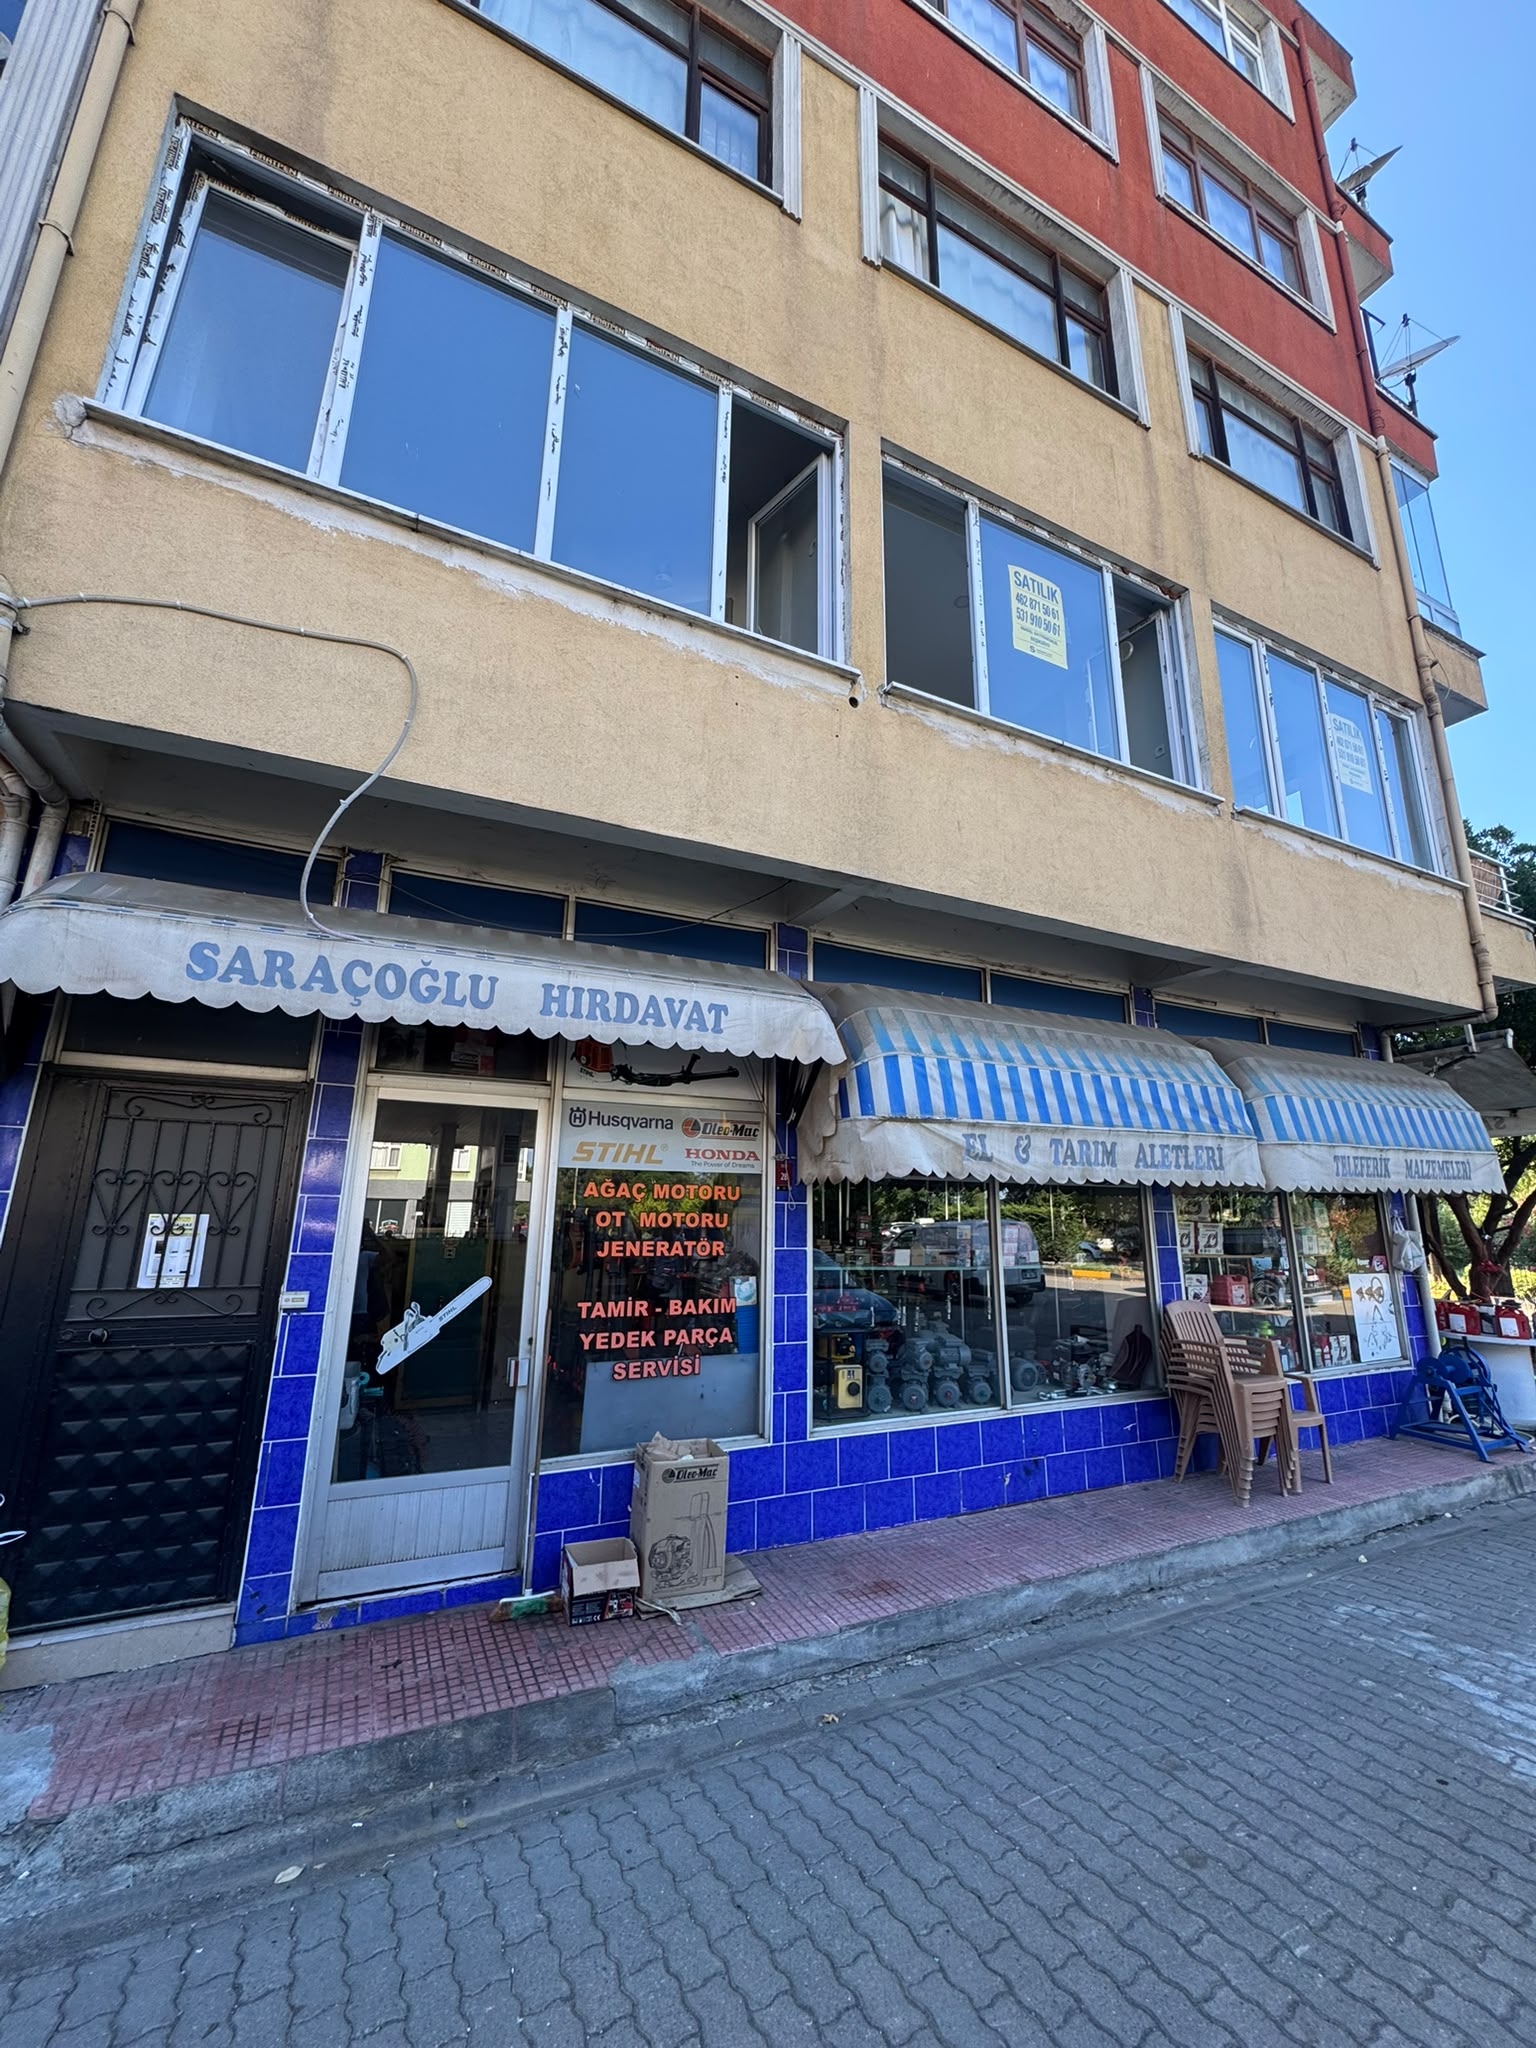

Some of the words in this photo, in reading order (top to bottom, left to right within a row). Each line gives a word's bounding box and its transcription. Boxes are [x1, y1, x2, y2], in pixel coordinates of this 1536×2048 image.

[1013, 570, 1059, 605] SATILIK
[1015, 591, 1029, 608] 462
[1029, 597, 1041, 613] 871
[1042, 602, 1051, 617] 50
[1051, 608, 1060, 621] 61
[1016, 606, 1028, 623] 531
[1029, 612, 1043, 629] 910
[1043, 618, 1052, 634] 50
[185, 941, 500, 1010] SARAÇOĞLU
[539, 983, 730, 1034] HIRDAVAT
[588, 1110, 674, 1131] Husqvarna
[702, 1122, 760, 1138] Oleo-Mac
[571, 1141, 664, 1165] STIHL
[684, 1148, 761, 1162] HONDA
[691, 1160, 703, 1168] The
[962, 1133, 994, 1163] EL
[1015, 1134, 1032, 1165] &
[1050, 1138, 1118, 1168] TARIM
[1134, 1141, 1225, 1171] ALETLERİ
[1333, 1154, 1392, 1180] TELEFERİK
[1404, 1157, 1473, 1181] MALZEMELERİ
[583, 1178, 647, 1203] AĞAÇ
[653, 1183, 741, 1201] MOTORU
[595, 1211, 626, 1228] OT
[639, 1212, 729, 1229] MOTORU
[596, 1238, 726, 1258] JENERATÖR
[577, 1297, 649, 1319] TAMİR
[669, 1297, 737, 1316] BAKIM
[579, 1330, 656, 1351] YEDEK
[663, 1327, 734, 1348] PARÇA
[613, 1353, 701, 1380] SERVİSİ
